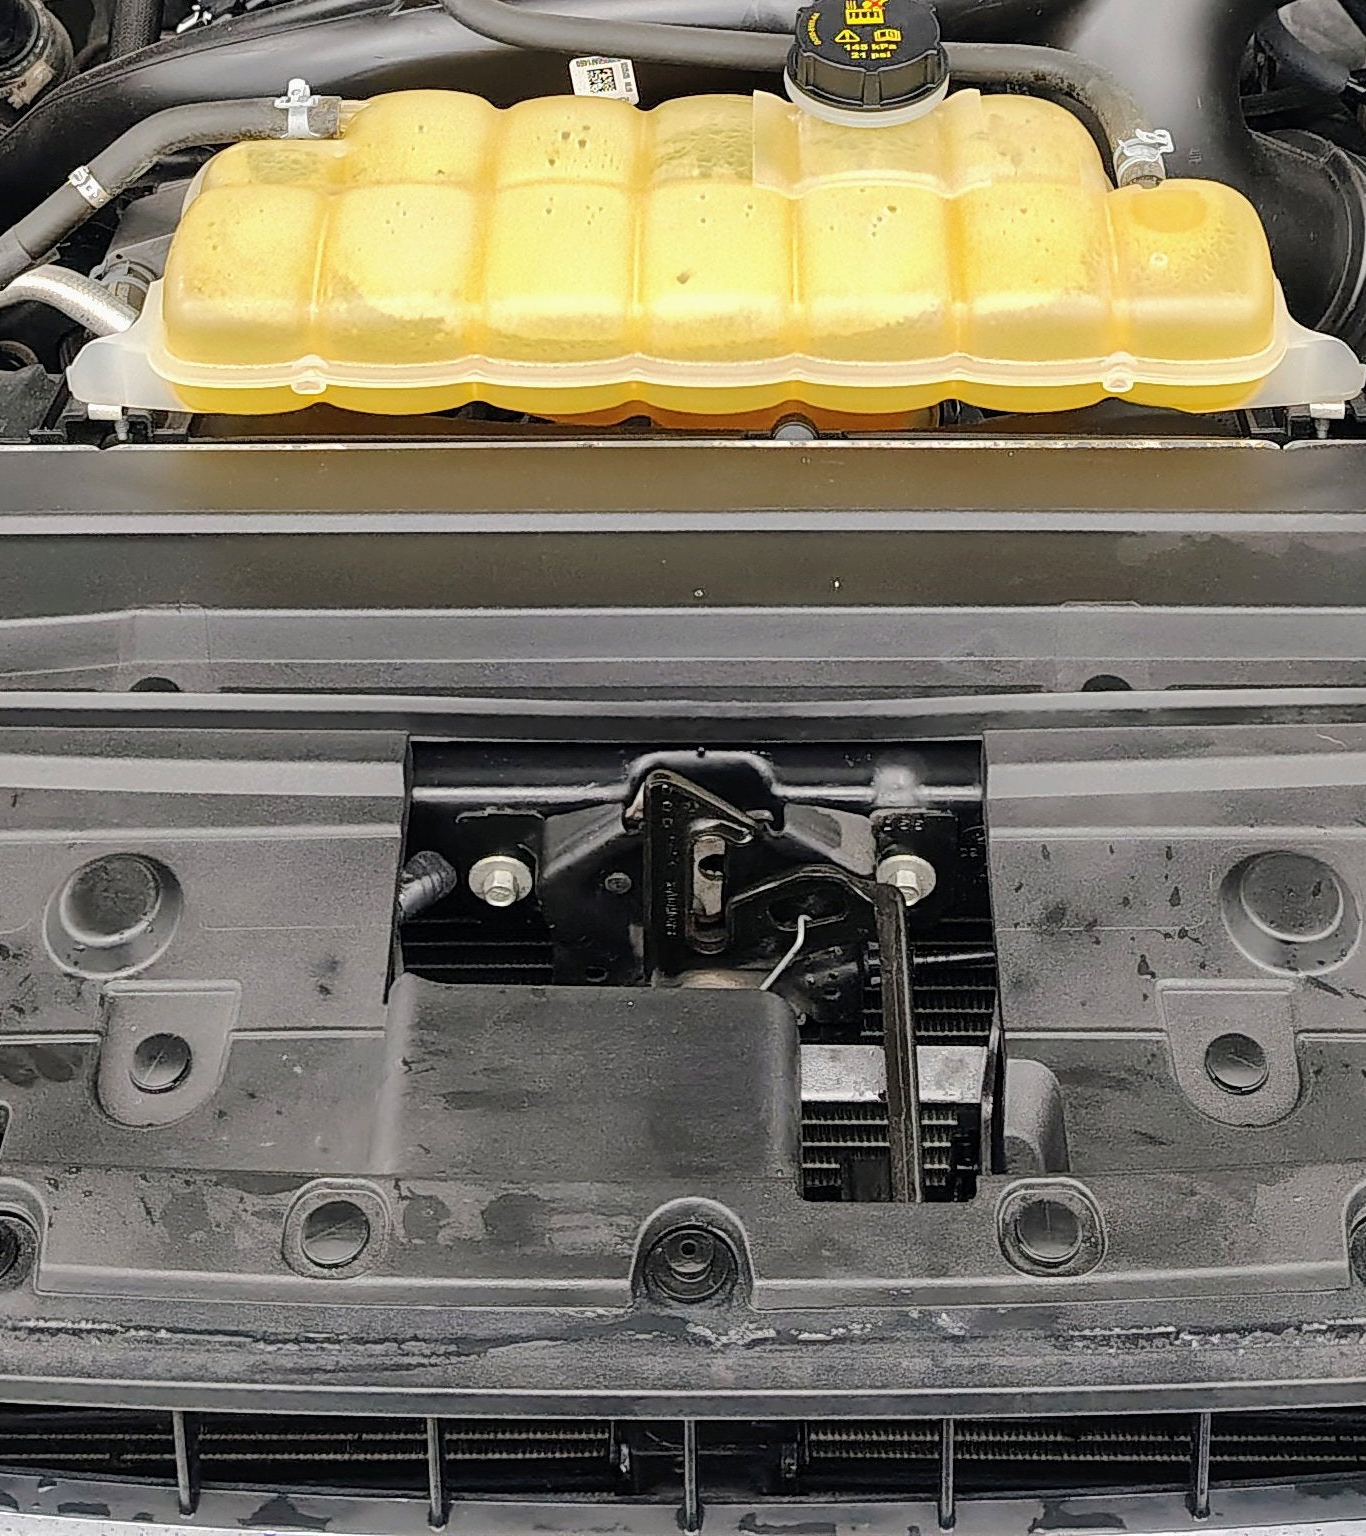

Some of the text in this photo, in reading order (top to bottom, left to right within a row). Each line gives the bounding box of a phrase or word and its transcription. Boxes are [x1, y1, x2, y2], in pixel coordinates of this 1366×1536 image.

[843, 43, 897, 51] 145 kPa
[850, 51, 891, 60] 21 psi
